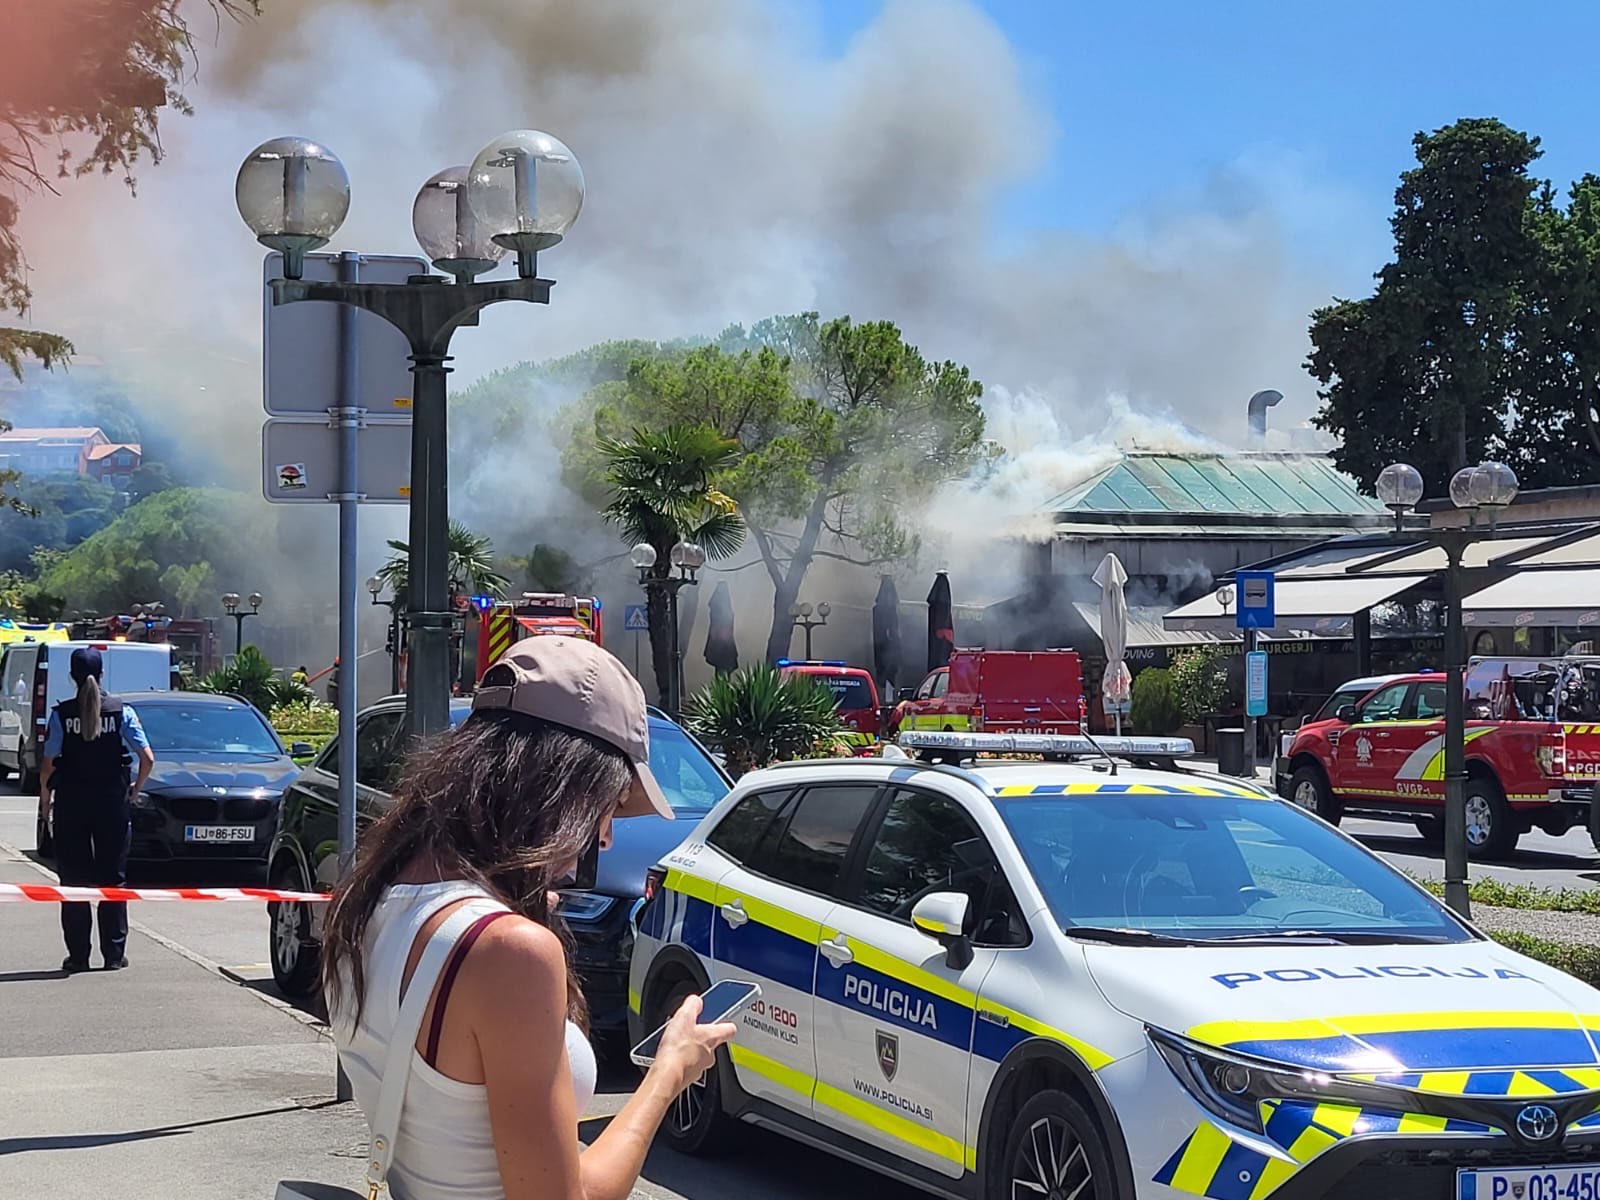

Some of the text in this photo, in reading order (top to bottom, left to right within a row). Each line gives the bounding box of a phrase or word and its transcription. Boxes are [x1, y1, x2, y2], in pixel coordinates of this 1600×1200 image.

[1166, 646, 1199, 657] PIZZ
[65, 715, 116, 734] POIJA
[195, 828, 252, 839] LJ 86-FSU
[1211, 966, 1544, 989] POLICIJA
[844, 973, 938, 1029] POLICIJA
[743, 1015, 779, 1038] ANONIMNI
[769, 1004, 797, 1028] 1200
[852, 1076, 933, 1120] WWW.POLICIJA.SI
[1492, 1176, 1508, 1200] P
